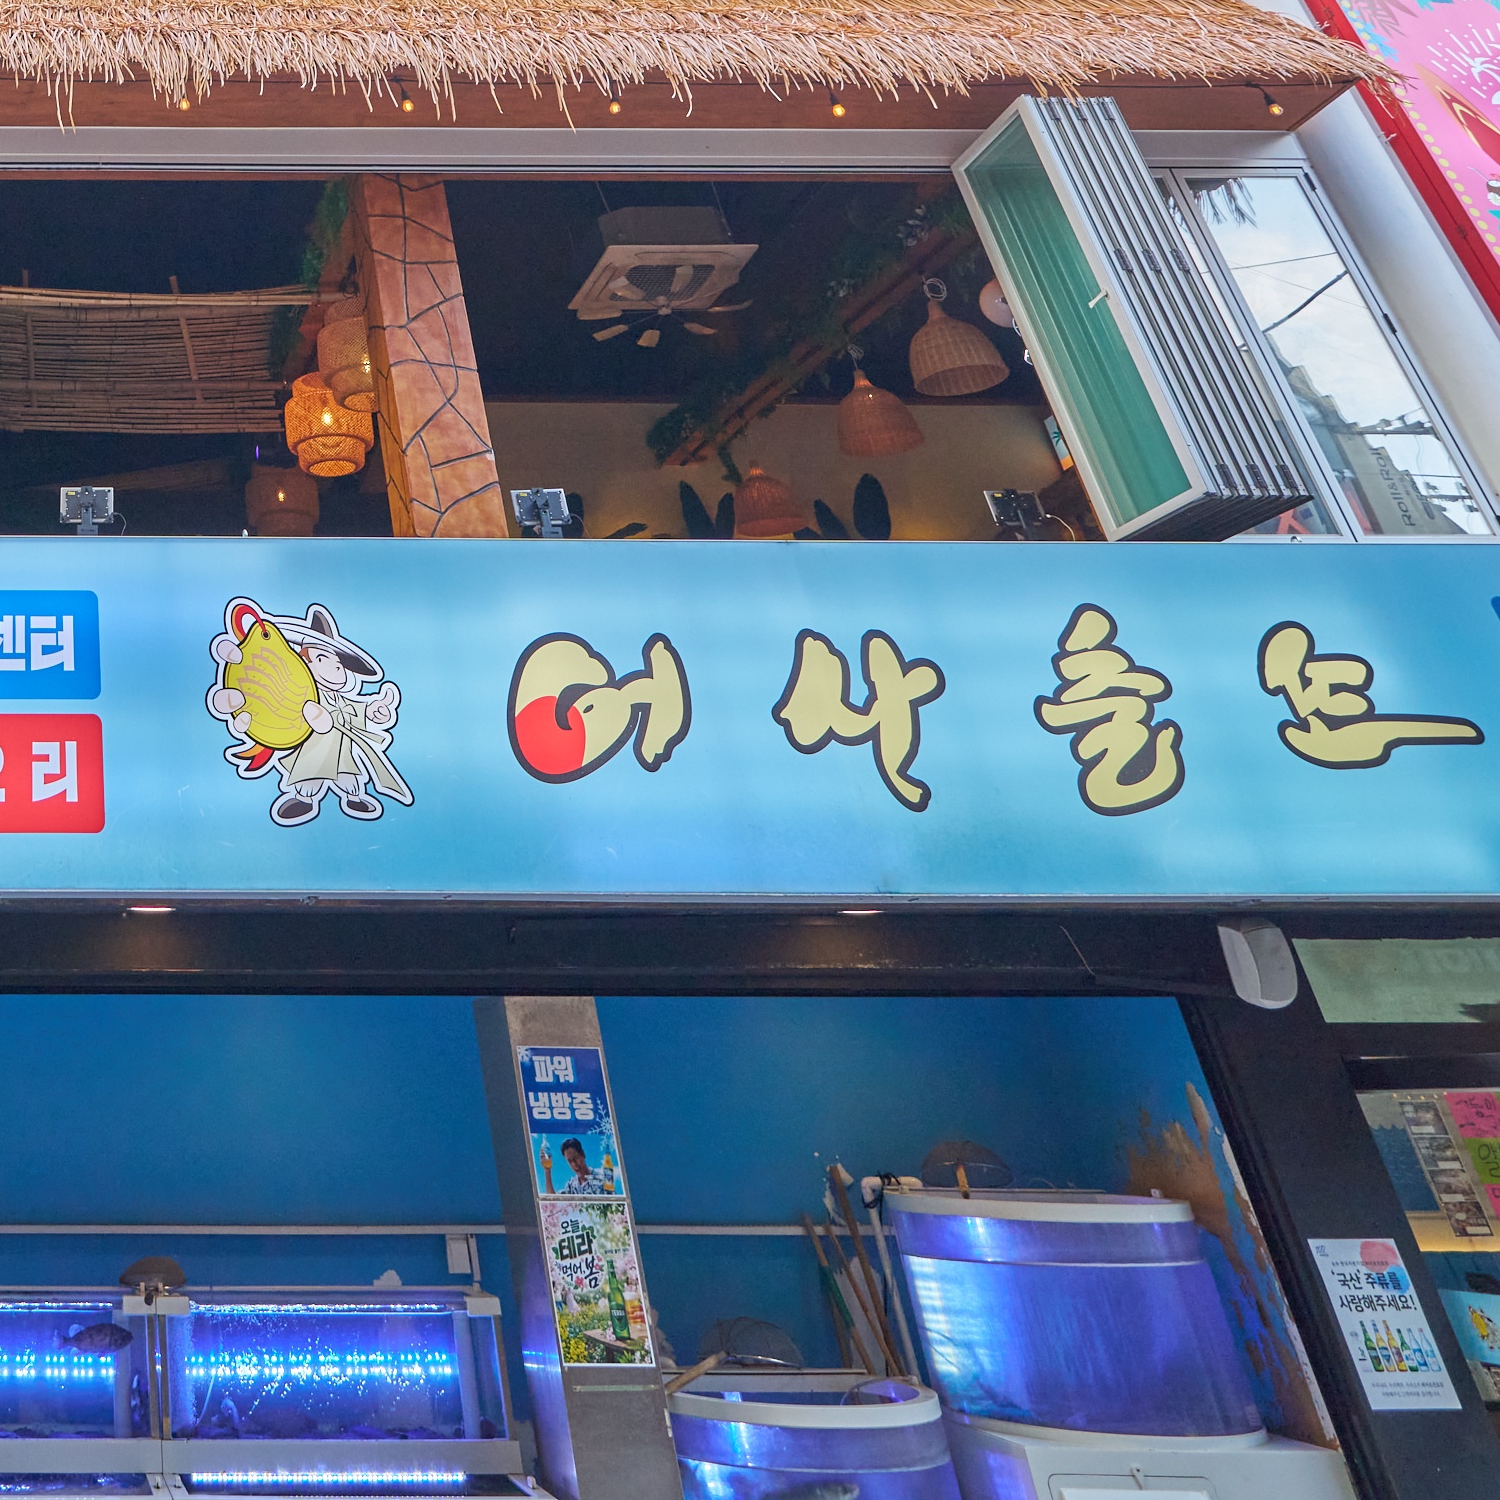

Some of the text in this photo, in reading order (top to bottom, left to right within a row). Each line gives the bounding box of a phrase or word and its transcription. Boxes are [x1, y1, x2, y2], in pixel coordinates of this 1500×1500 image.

[533, 1055, 575, 1083] 파워
[528, 1091, 595, 1121] 냉방중
[560, 1218, 581, 1235] 오늘
[558, 1231, 594, 1261] 테라
[1364, 1271, 1403, 1290] 주류를
[1339, 1294, 1418, 1313] 사랑해주세요!
